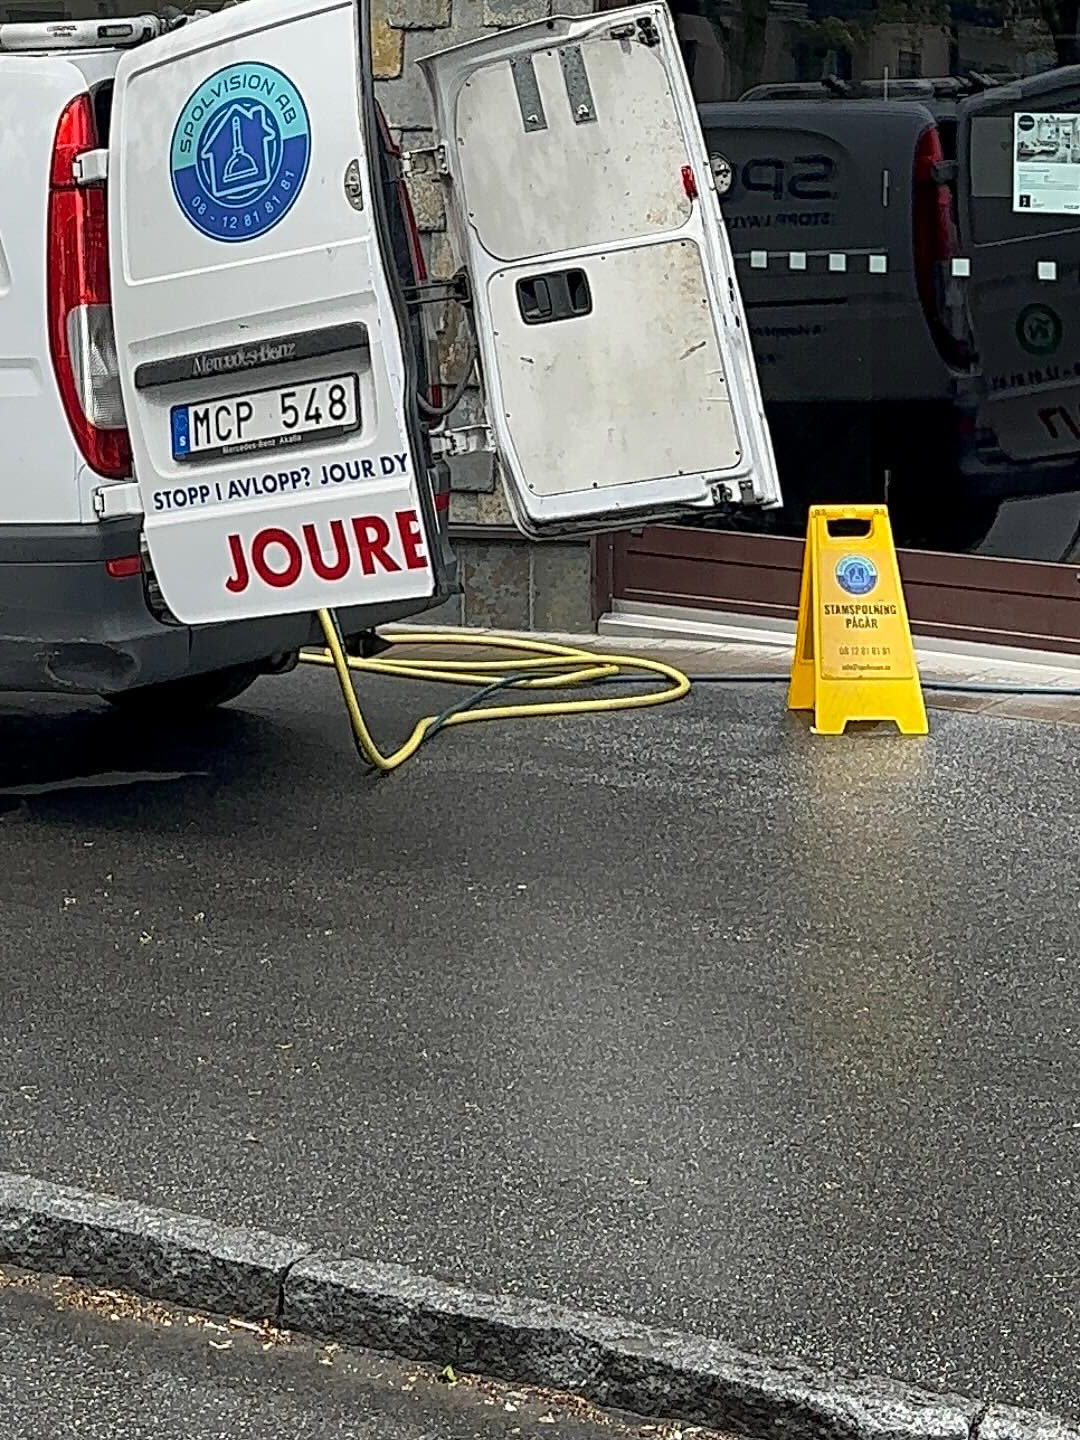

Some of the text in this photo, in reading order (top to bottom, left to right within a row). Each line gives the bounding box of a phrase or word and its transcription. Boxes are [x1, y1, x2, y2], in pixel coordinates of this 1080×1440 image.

[180, 74, 297, 153] SPOLVISION AB
[191, 196, 207, 215] 08
[223, 216, 236, 229] 12
[244, 211, 260, 226] 81
[265, 195, 281, 213] 81
[281, 171, 295, 190] 81
[179, 438, 187, 446] S
[193, 384, 346, 446] MCP 548
[153, 452, 408, 511] STOPP I AVLOPP? JOUR DY
[824, 604, 897, 615] STAMSPOLNING
